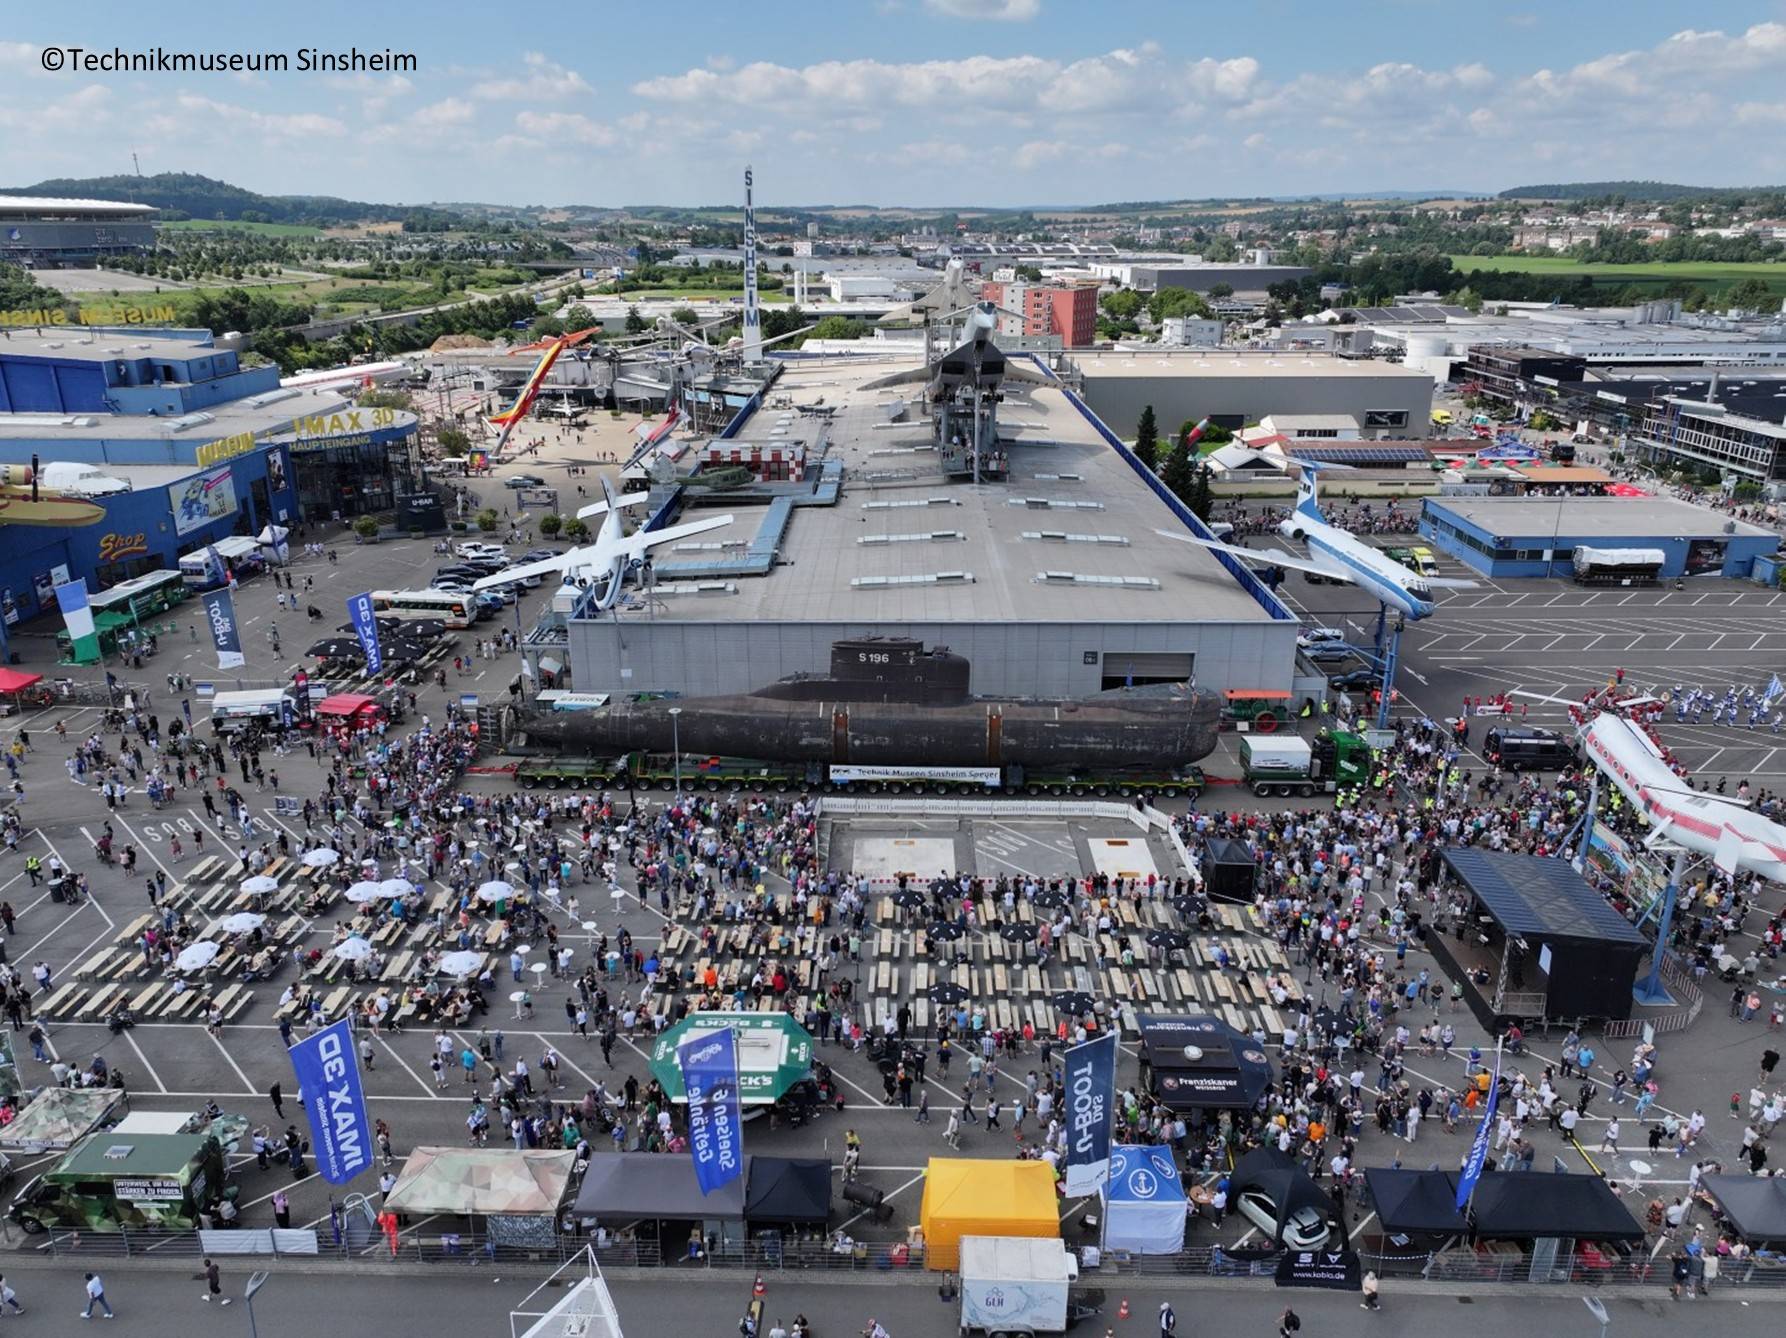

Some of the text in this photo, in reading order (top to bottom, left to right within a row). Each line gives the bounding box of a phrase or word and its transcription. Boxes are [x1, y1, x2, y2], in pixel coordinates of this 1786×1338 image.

[743, 170, 760, 328] SINSHEIM
[196, 432, 255, 468] MUSEUM
[293, 411, 362, 435] IMAX
[372, 407, 394, 426] 3D
[289, 435, 371, 451] HAUPTEINGANG
[98, 532, 148, 560] Shop
[859, 652, 890, 663] S 196
[857, 768, 998, 780] Technik Museen Sinsheim Speyer
[143, 817, 195, 842] BUS
[224, 816, 272, 841] BS
[1179, 1078, 1237, 1087] Franziskaner
